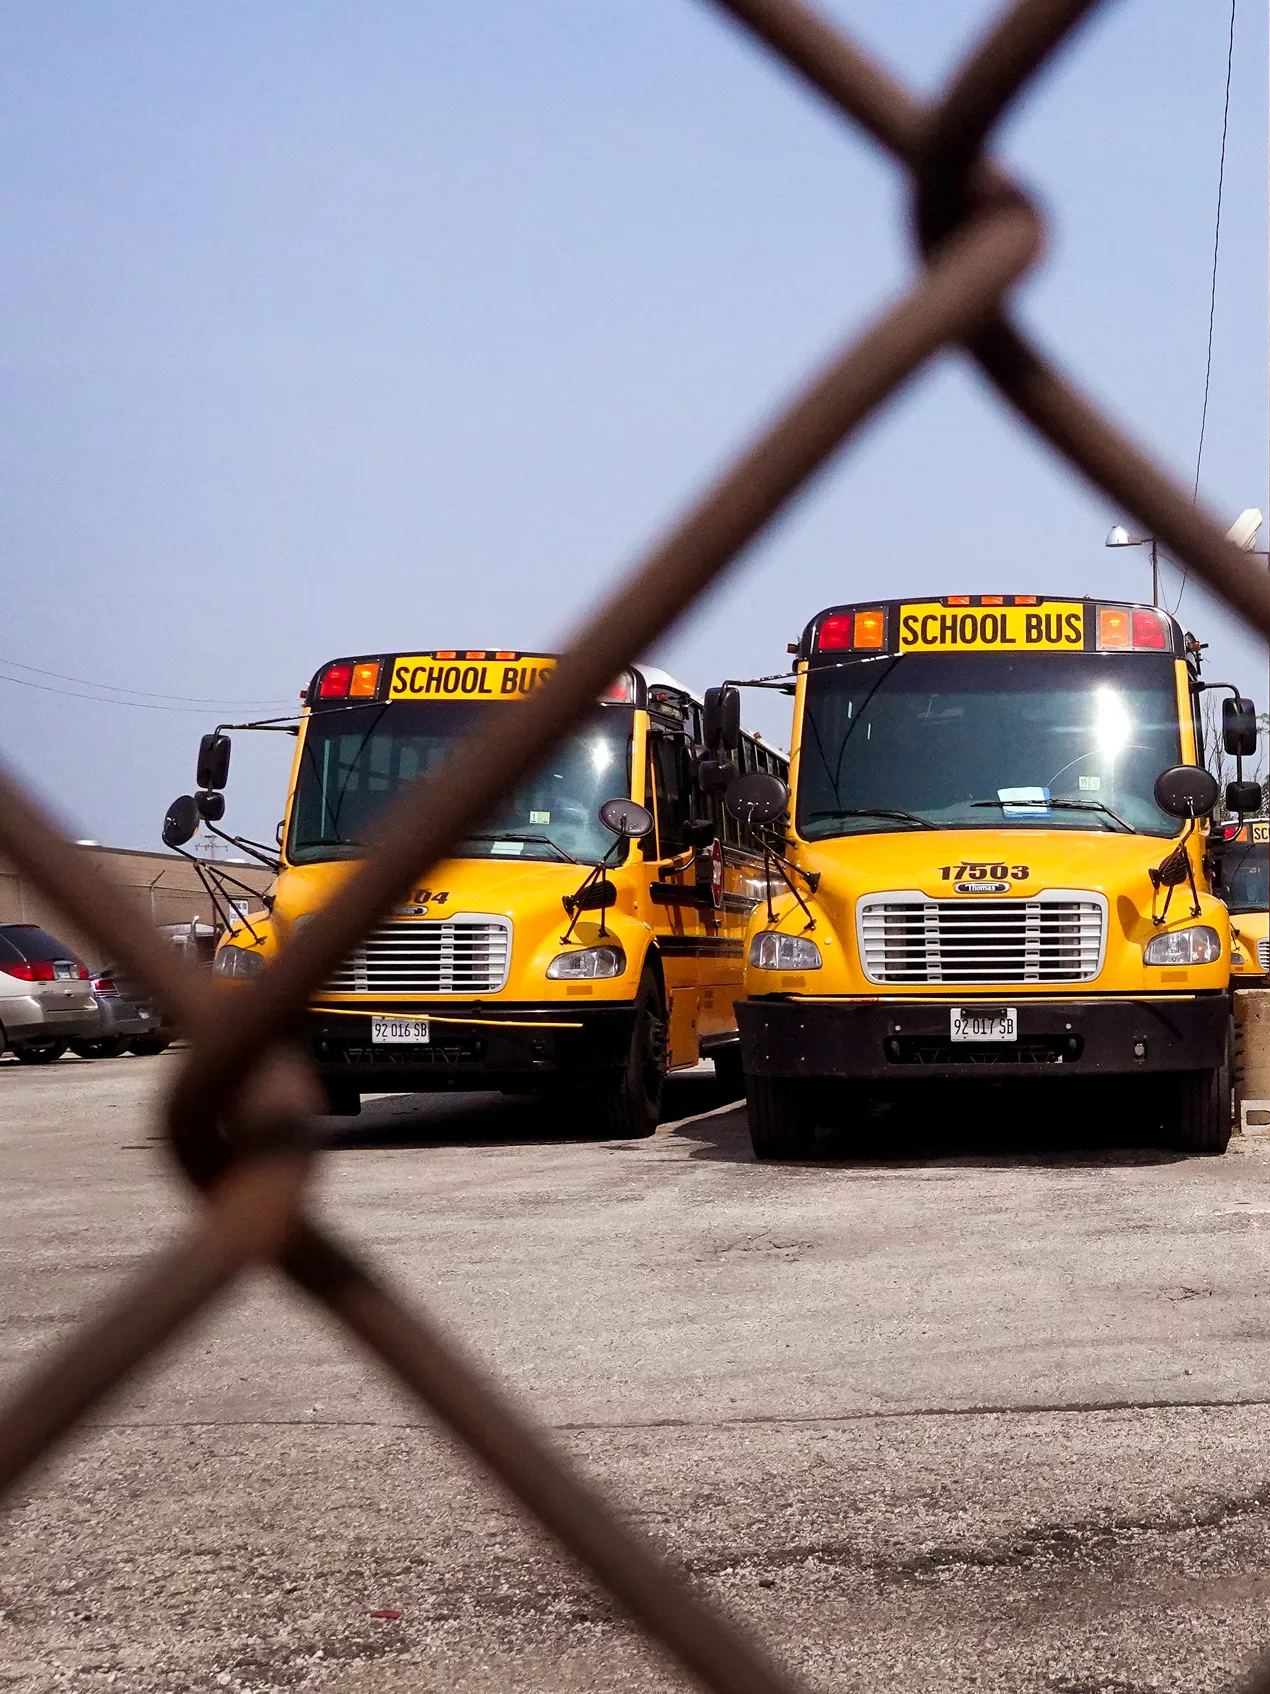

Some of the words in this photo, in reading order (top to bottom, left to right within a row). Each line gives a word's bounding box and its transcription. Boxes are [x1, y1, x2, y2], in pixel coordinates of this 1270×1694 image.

[901, 614, 1016, 645] SCHOOL
[1025, 614, 1082, 644] BUS
[392, 666, 492, 694] SCHOOL
[937, 865, 1030, 881] 17503
[375, 1023, 388, 1038] 92
[391, 1023, 411, 1038] 016
[414, 1022, 427, 1037] SB
[954, 1018, 969, 1035] 92
[972, 1018, 995, 1035] 017
[999, 1018, 1014, 1035] SB
